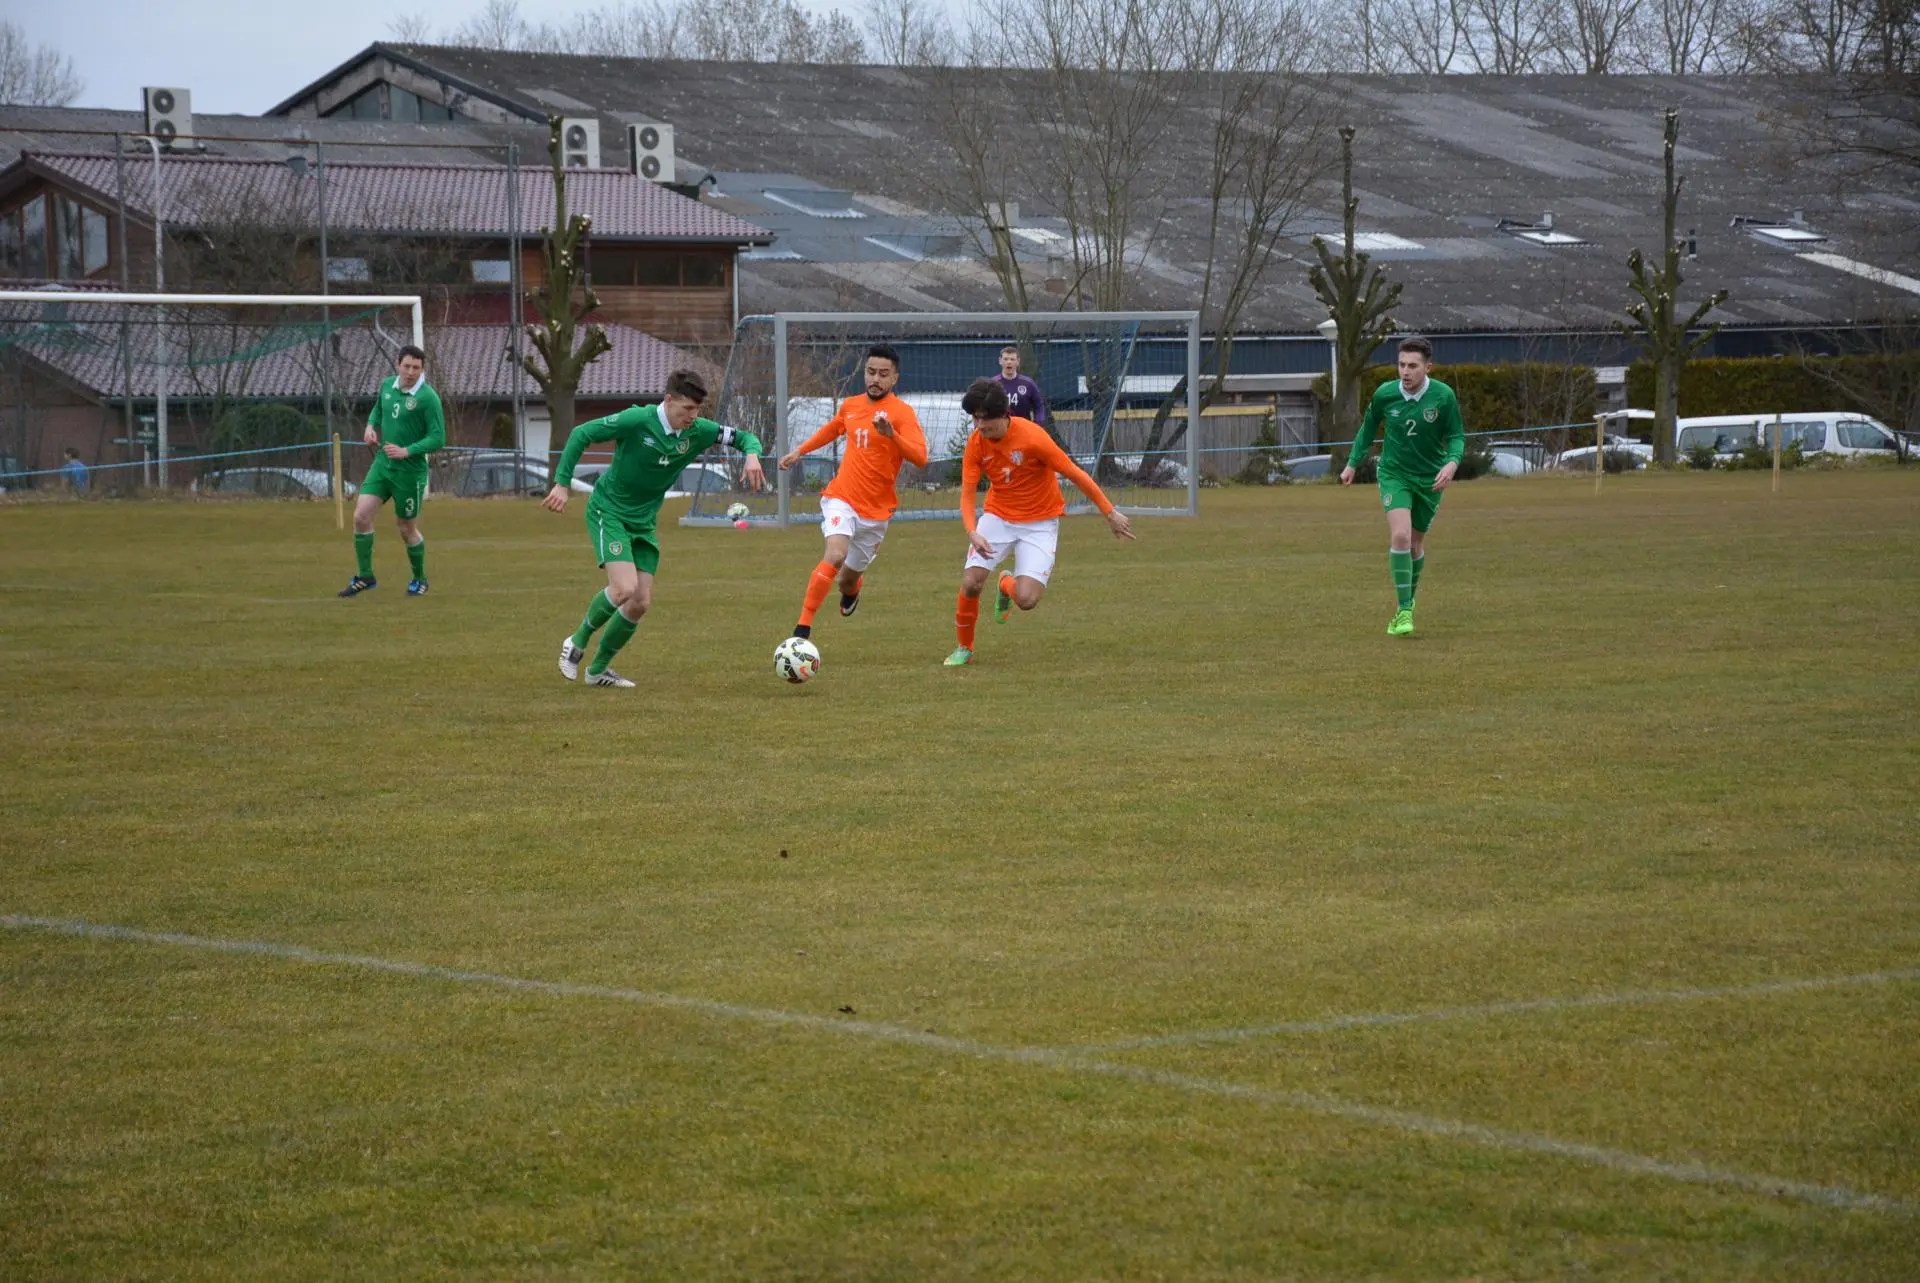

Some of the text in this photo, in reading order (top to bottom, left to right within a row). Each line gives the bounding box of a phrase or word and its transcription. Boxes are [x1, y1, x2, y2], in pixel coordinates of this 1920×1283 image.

[1006, 392, 1018, 406] 14
[391, 402, 400, 419] 3
[1405, 418, 1418, 436] 2
[855, 427, 869, 449] 11
[658, 454, 670, 467] 4
[404, 498, 414, 511] 3
